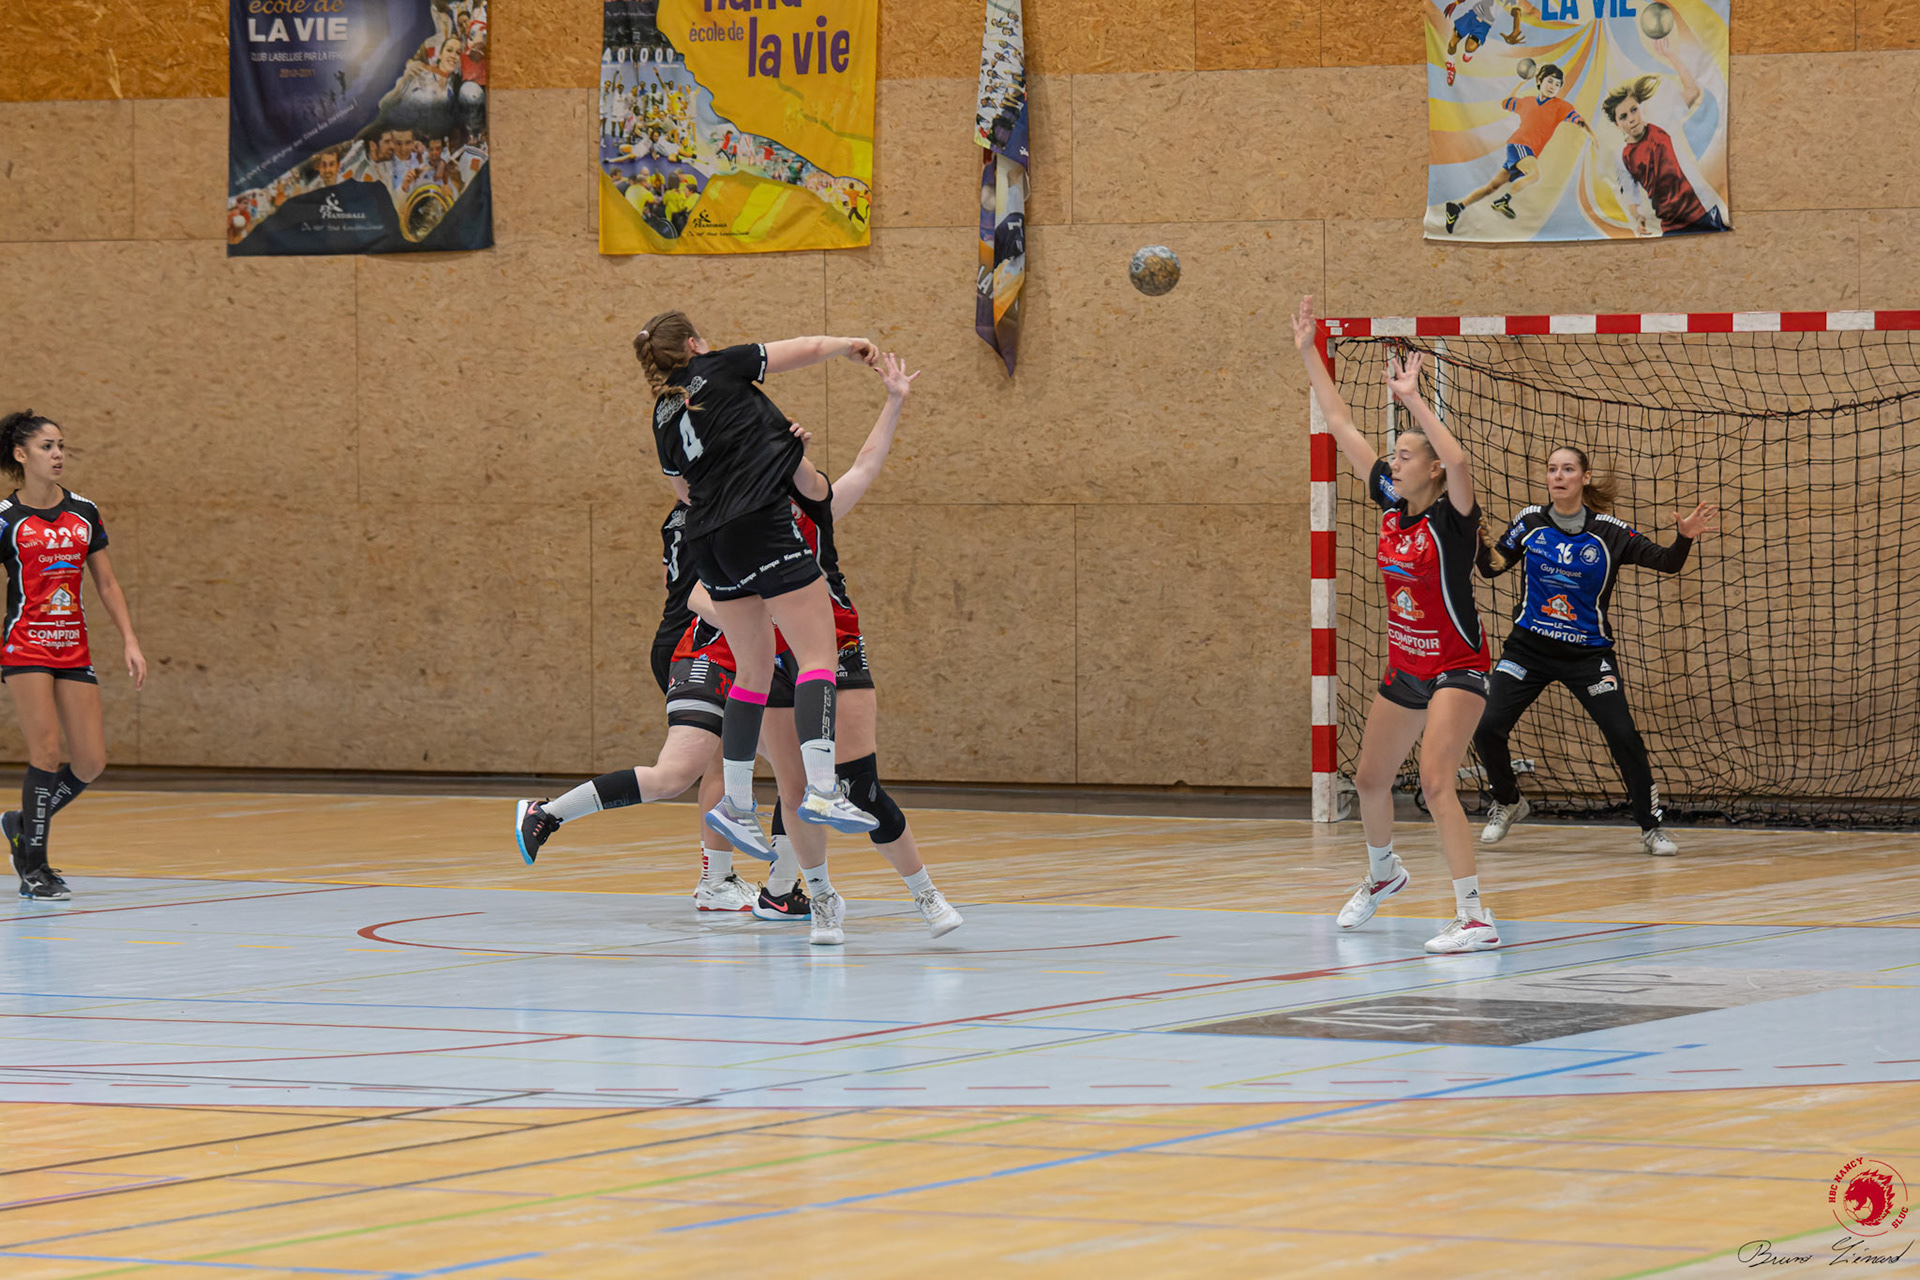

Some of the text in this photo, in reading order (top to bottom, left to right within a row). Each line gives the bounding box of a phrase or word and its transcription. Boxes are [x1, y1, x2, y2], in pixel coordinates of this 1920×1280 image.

[248, 17, 348, 42] LA VIE
[689, 20, 745, 42] école de
[748, 15, 850, 78] la vie
[679, 410, 704, 462] 4
[43, 527, 74, 550] 22
[38, 554, 53, 564] Guy
[1555, 542, 1574, 565] 16
[760, 559, 780, 572] Kempa
[1540, 563, 1555, 575] Guy
[55, 620, 66, 628] LE
[1388, 628, 1440, 649] COMPTOIR
